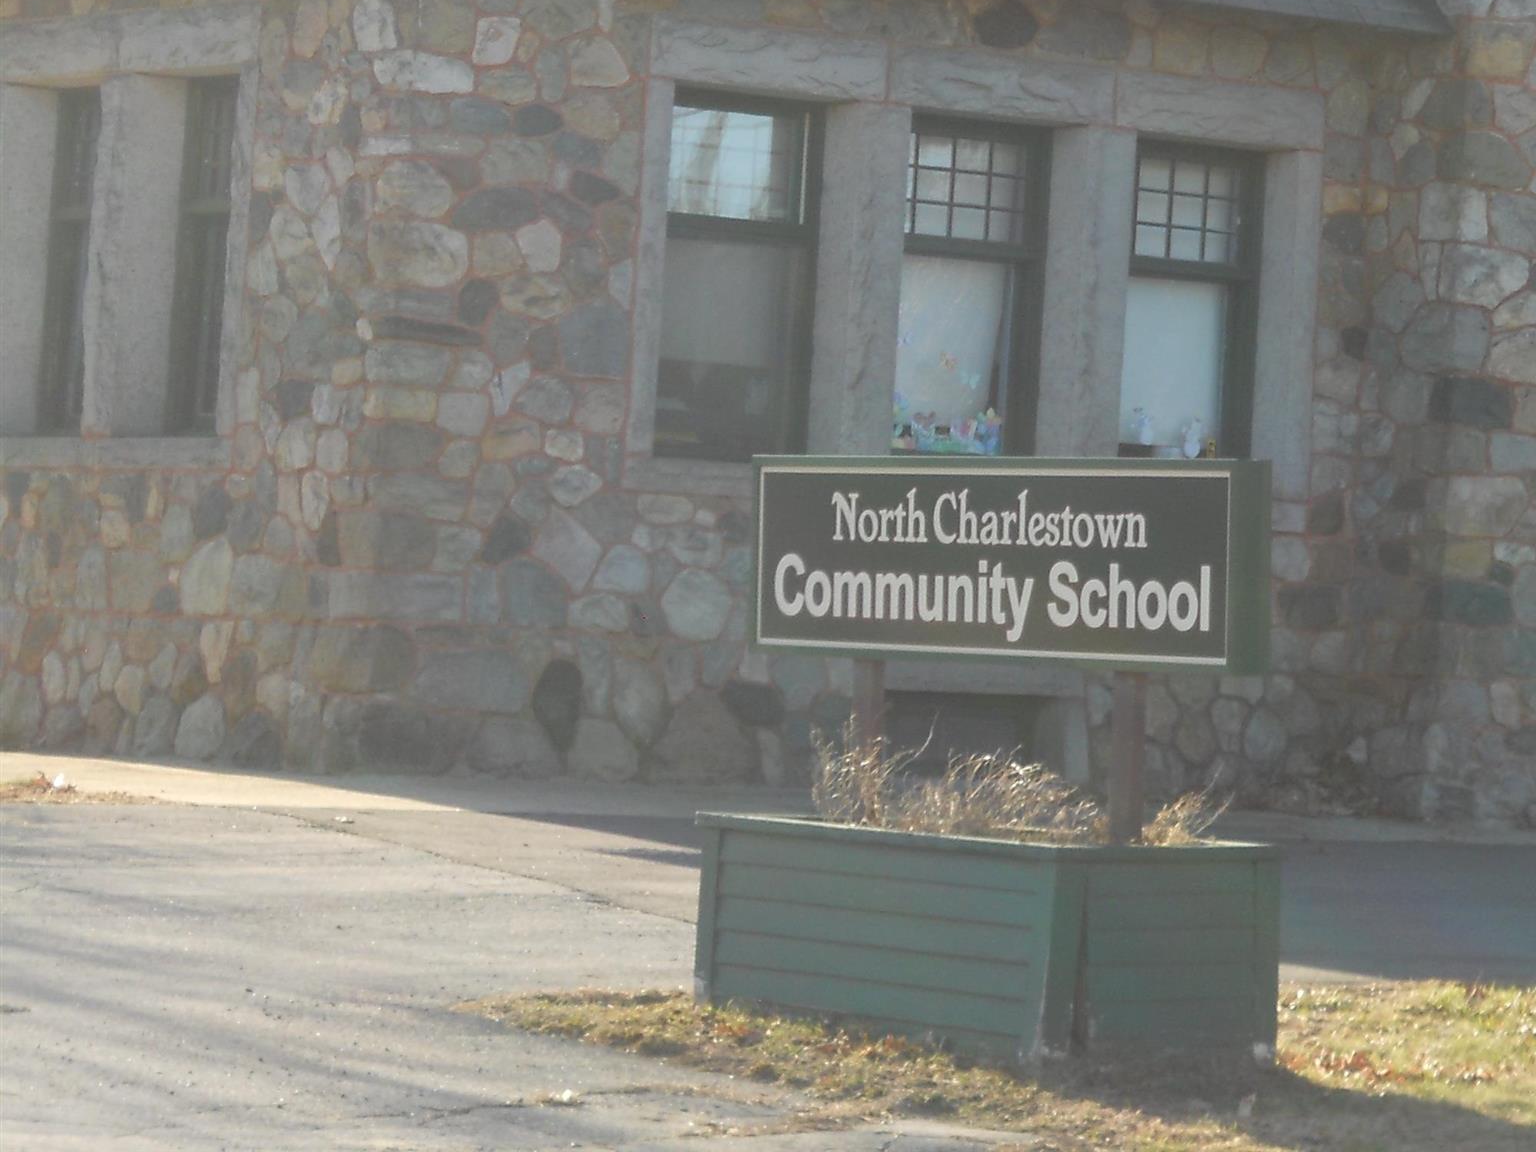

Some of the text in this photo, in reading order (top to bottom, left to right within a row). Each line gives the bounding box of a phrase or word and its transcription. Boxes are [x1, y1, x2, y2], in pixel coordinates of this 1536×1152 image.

[831, 487, 1148, 549] North Charlestown
[774, 553, 1211, 642] Community School
